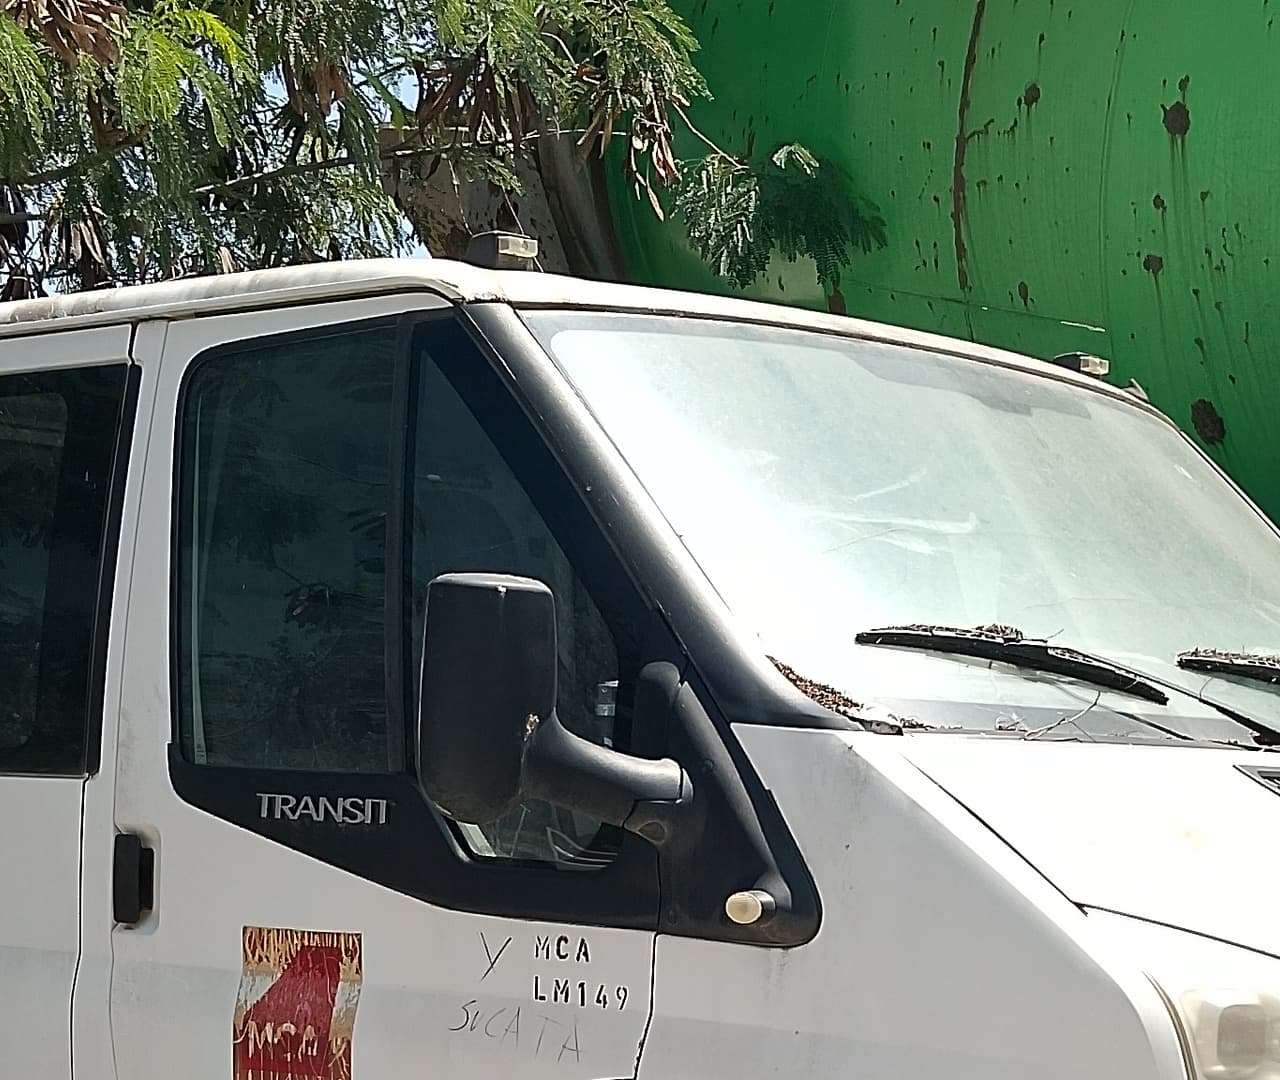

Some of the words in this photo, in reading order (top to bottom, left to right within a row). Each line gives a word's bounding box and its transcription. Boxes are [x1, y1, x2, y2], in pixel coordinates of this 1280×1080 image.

[255, 792, 387, 825] TRANSIT
[534, 935, 590, 963] MCA
[533, 975, 629, 1011] LM149
